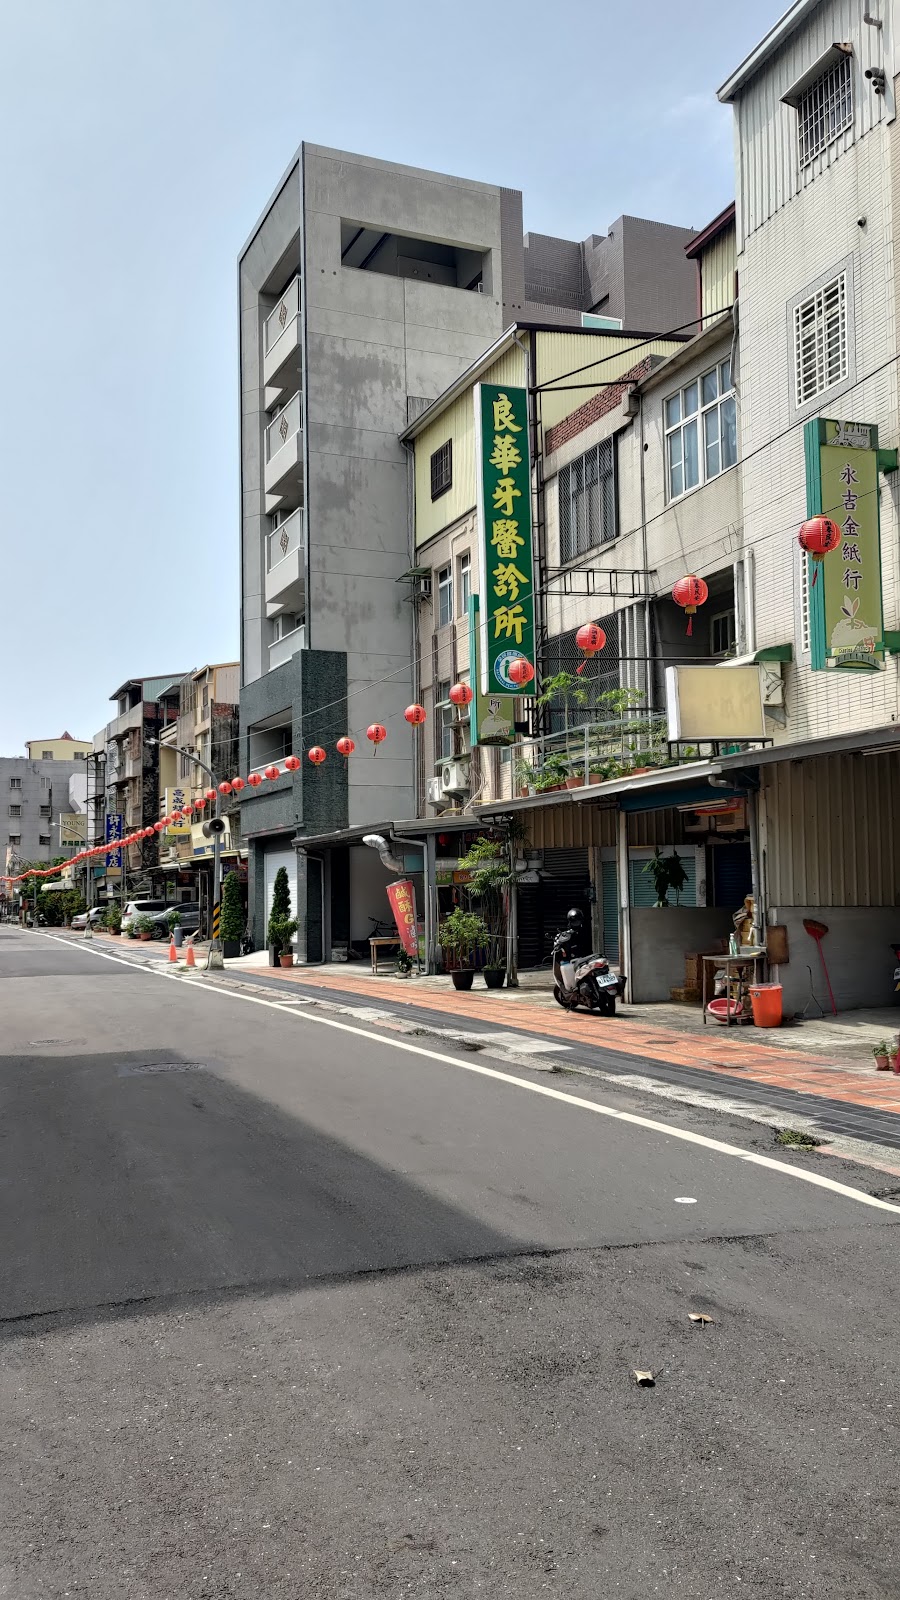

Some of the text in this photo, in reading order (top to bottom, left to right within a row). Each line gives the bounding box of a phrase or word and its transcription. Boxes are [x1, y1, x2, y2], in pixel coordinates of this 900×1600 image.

[489, 393, 529, 644] 良華牙醫診所
[839, 463, 864, 592] 永吉金紙行
